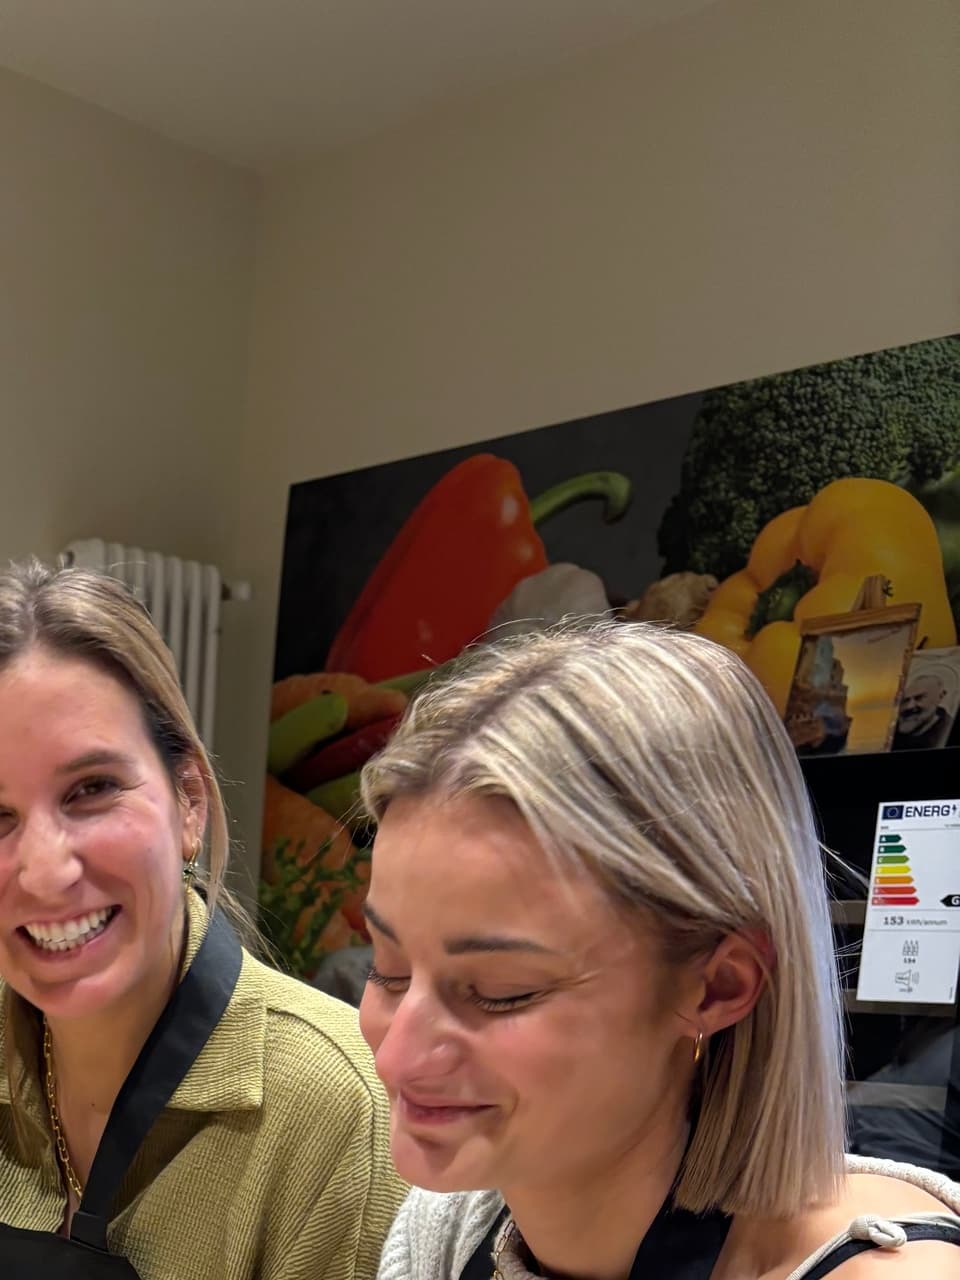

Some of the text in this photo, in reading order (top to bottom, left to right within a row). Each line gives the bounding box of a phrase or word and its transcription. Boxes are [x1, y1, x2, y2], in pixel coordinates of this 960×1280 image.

[905, 805, 951, 818] ENERG
[951, 895, 960, 906] G
[883, 916, 905, 926] 153
